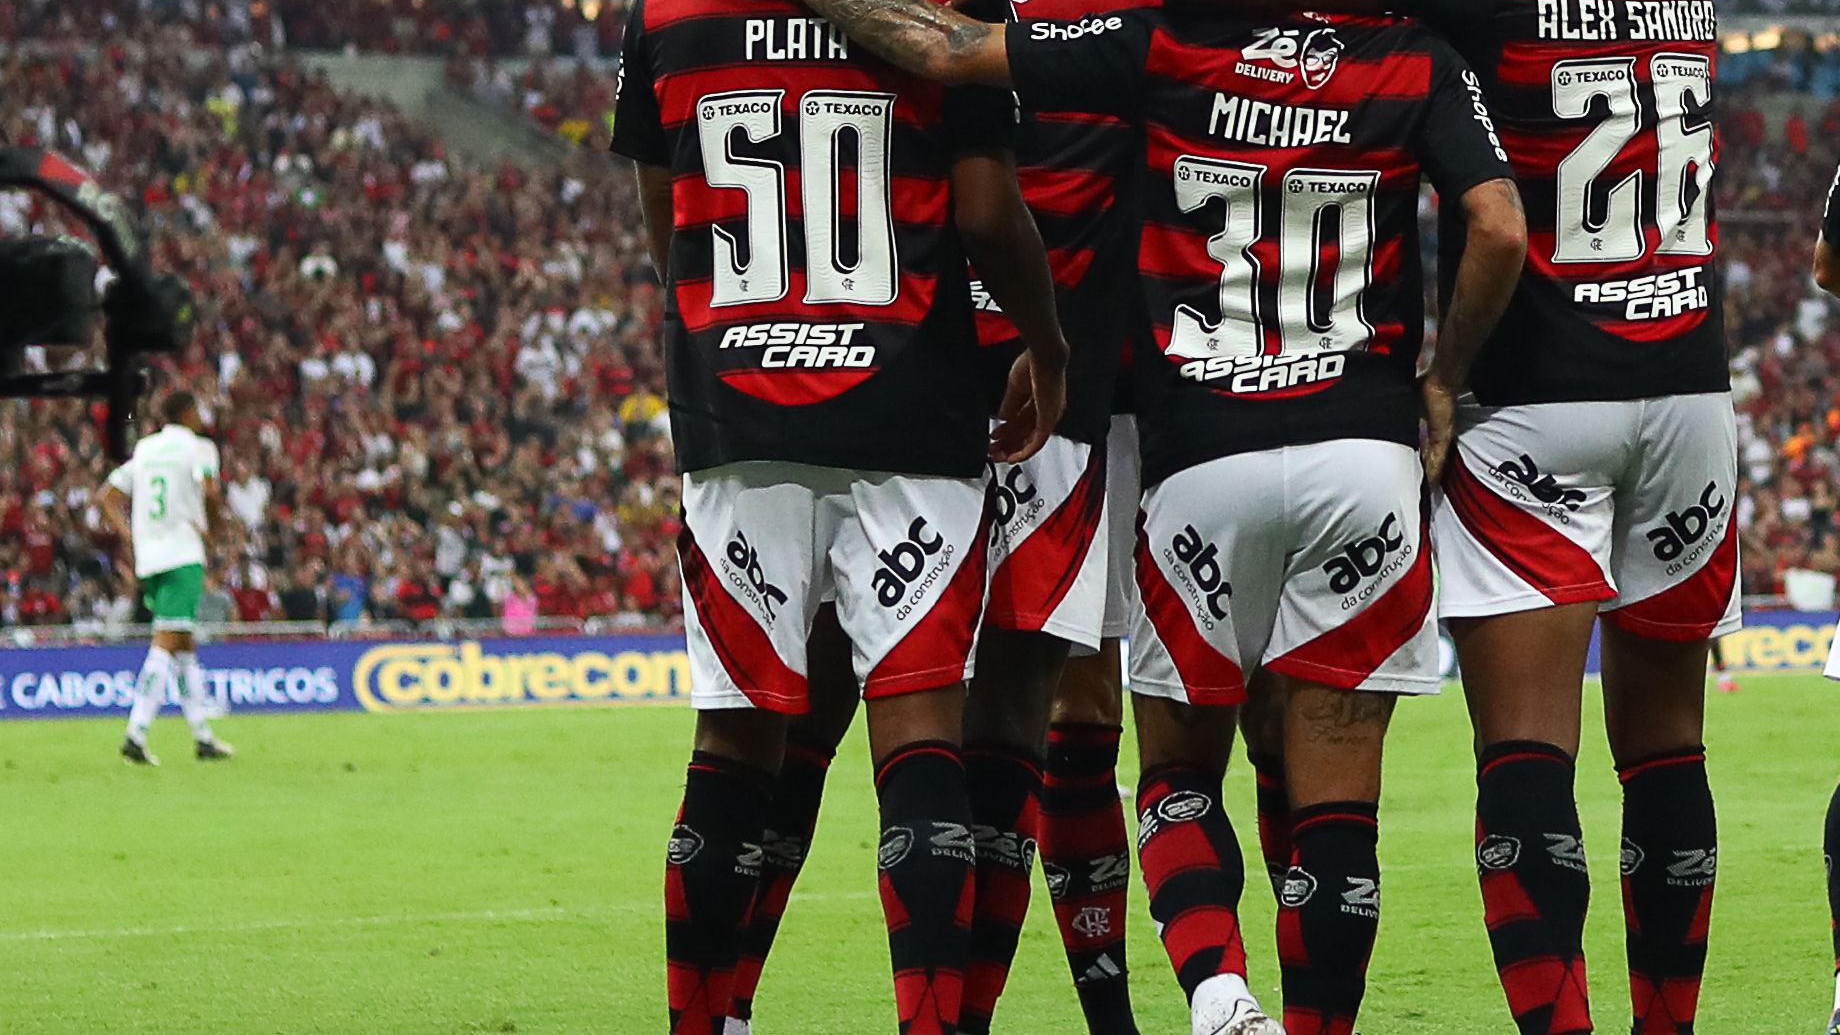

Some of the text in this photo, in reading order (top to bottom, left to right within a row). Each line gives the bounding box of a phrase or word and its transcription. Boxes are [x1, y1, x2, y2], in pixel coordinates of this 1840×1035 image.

[746, 18, 848, 60] PLATA
[1627, 0, 1716, 41] SANDRO
[1241, 27, 1299, 68] Zé
[1235, 62, 1295, 84] DELIVERY
[1575, 69, 1625, 84] TEXACO
[718, 102, 771, 117] TEXACO
[824, 102, 882, 117] TEXACO
[1208, 93, 1352, 146] MICHAEL
[1462, 69, 1508, 163] Shopee
[1551, 52, 1715, 263] 26
[697, 89, 899, 308] 50
[1194, 169, 1251, 188] TEXACO
[1308, 181, 1368, 194] TEXACO
[1165, 154, 1381, 359] 30
[1625, 286, 1708, 320] CARD
[720, 324, 864, 349] ASSIST
[762, 346, 876, 368] CARD
[1232, 354, 1346, 393] CARD
[149, 476, 167, 519] 3
[1646, 480, 1725, 562] abc
[871, 516, 944, 608] abc
[1172, 523, 1233, 622] abc
[1322, 511, 1404, 595] abc
[1666, 562, 1682, 576] da
[896, 543, 954, 621] da construção
[1341, 542, 1413, 611] da construção
[11, 670, 134, 709] CABOS
